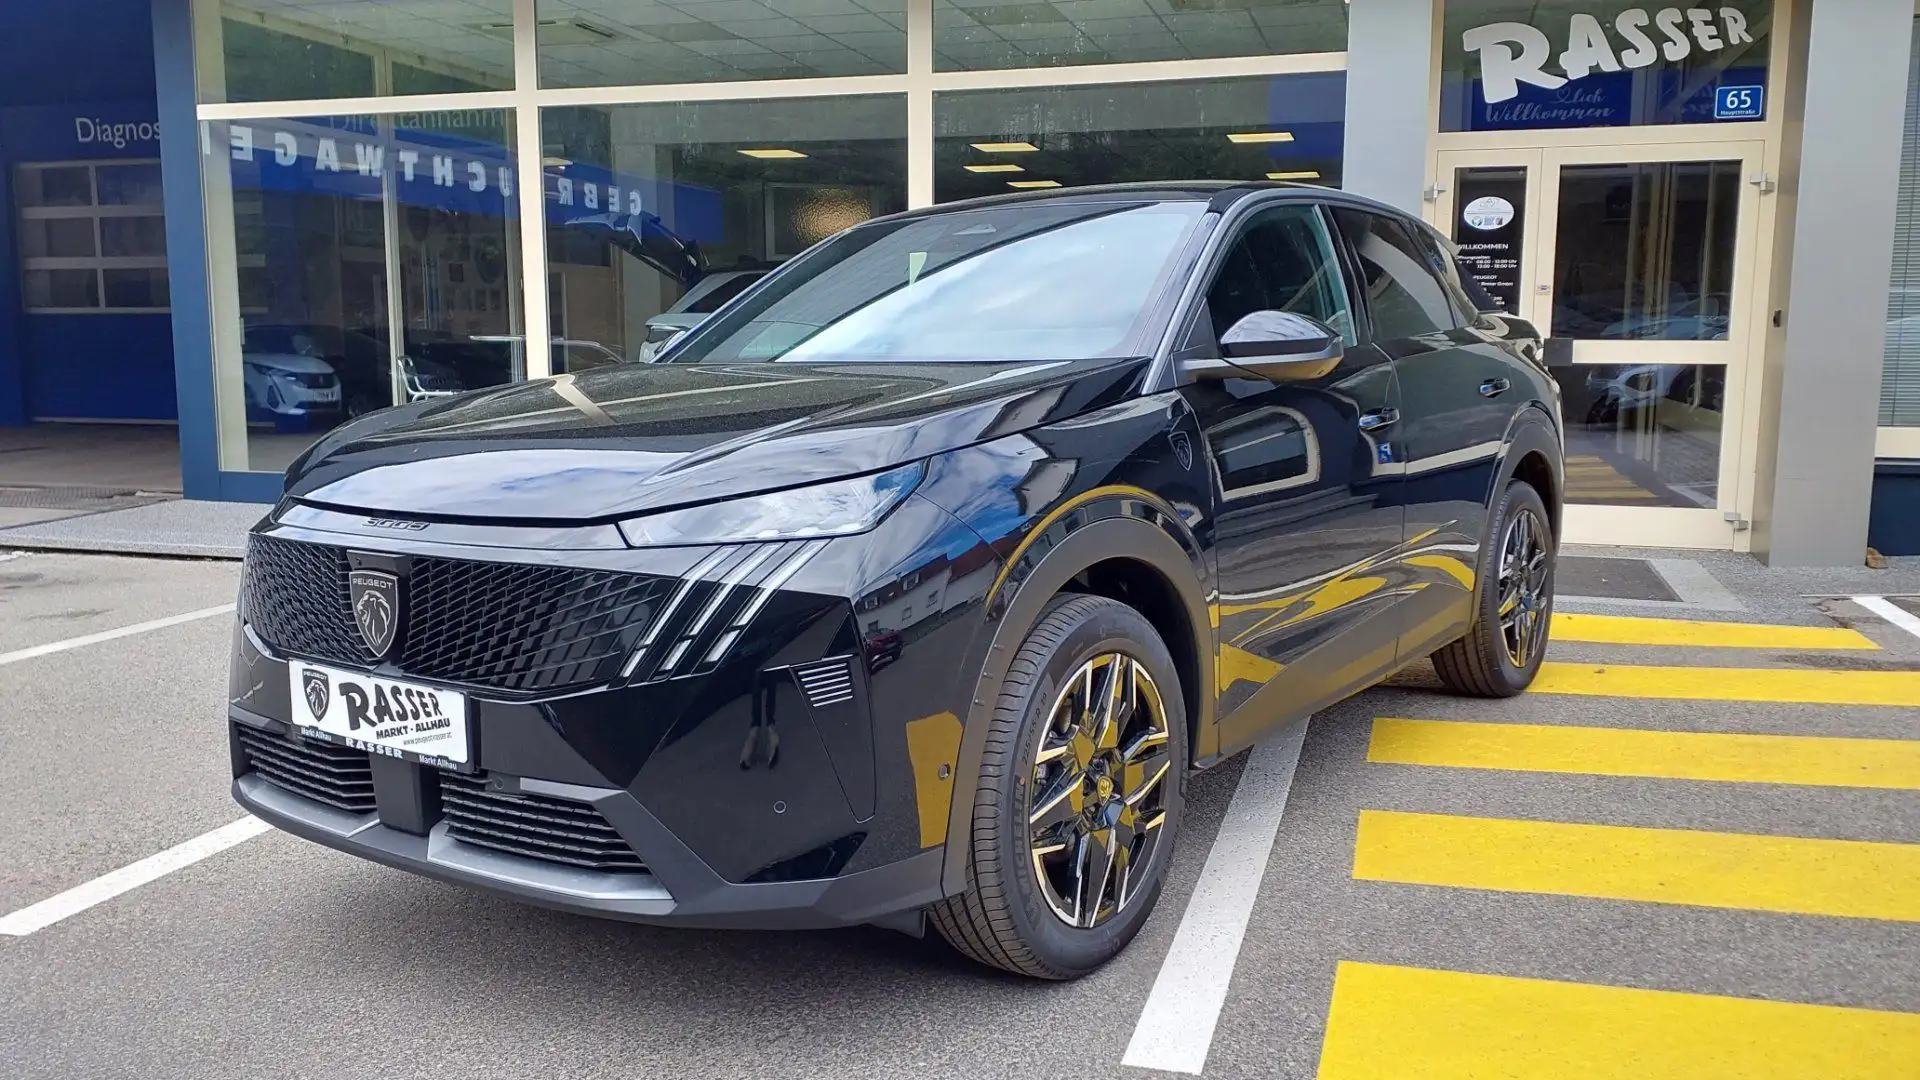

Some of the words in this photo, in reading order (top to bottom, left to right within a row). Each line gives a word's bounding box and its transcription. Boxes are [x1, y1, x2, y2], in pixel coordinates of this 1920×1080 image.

[1463, 8, 1753, 103] RASSER
[1727, 90, 1751, 109] 65
[1485, 102, 1615, 123] Willkommen
[352, 577, 393, 590] PEUGEOT
[338, 681, 443, 731] RASSER
[301, 727, 315, 737] Markt
[376, 725, 409, 740] MARKT
[415, 718, 450, 733] ALLHAU
[345, 737, 403, 759] RASSER
[419, 754, 437, 766] Markt
